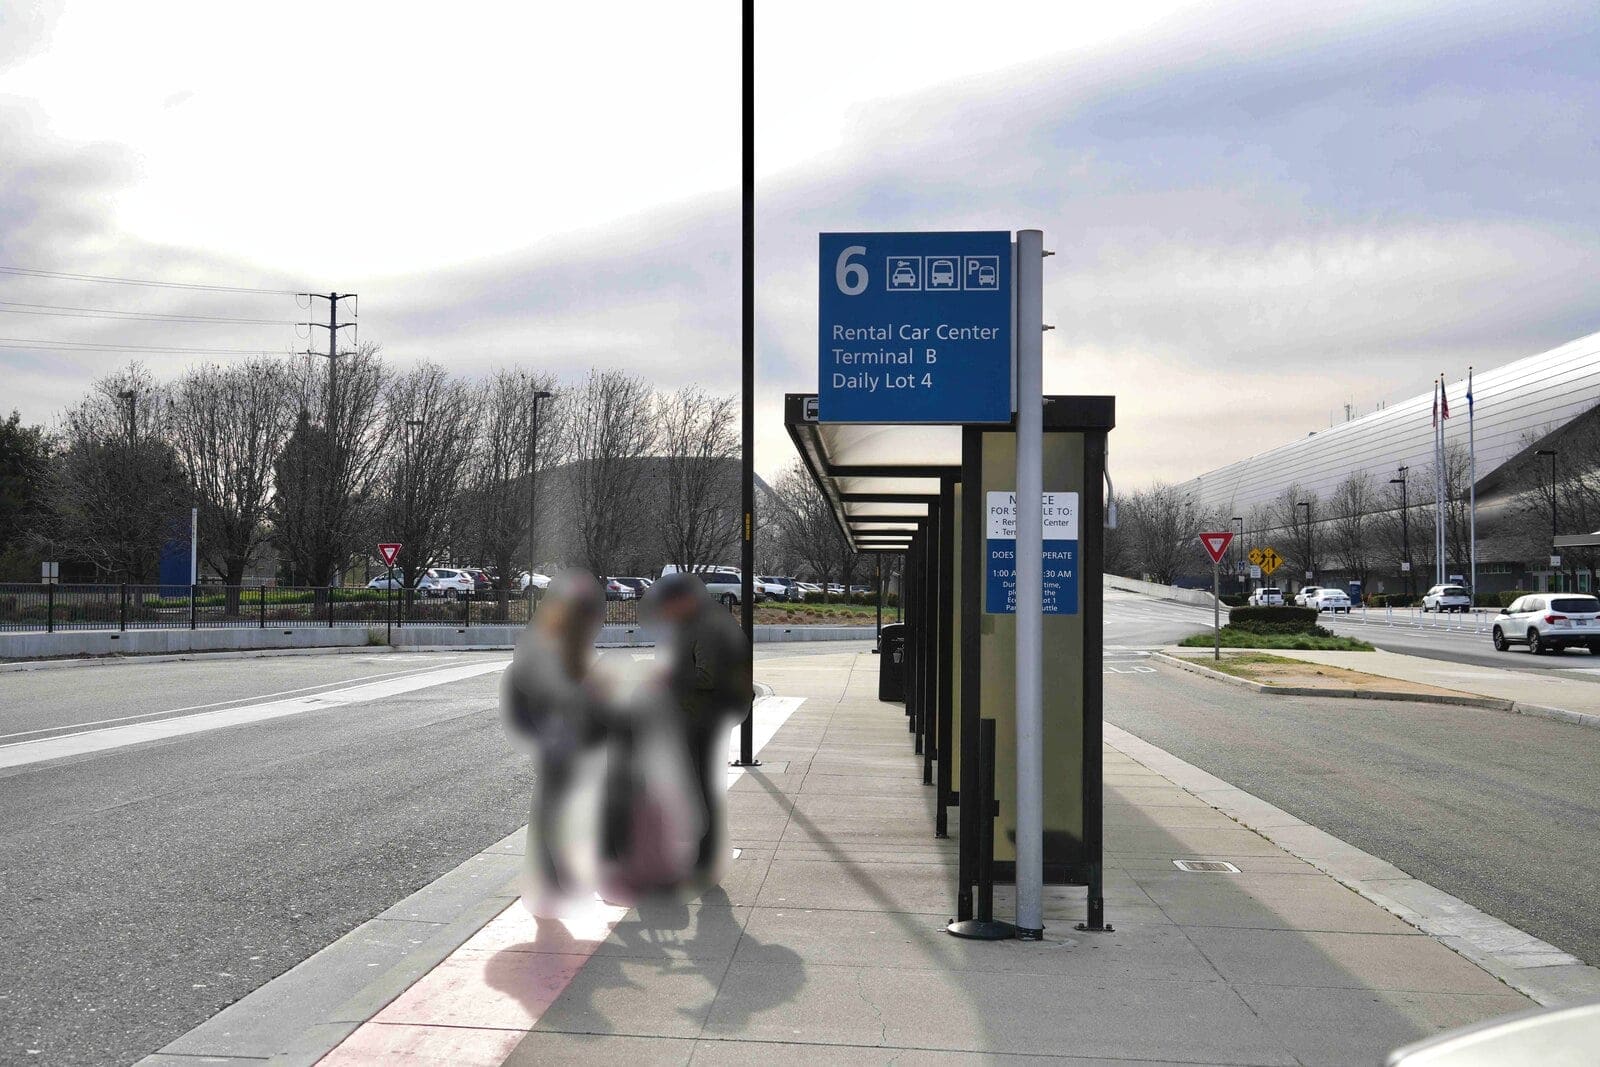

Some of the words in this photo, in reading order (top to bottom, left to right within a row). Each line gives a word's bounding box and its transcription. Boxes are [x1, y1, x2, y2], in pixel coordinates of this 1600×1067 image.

[835, 245, 869, 296] 6
[968, 260, 980, 275] P
[832, 323, 892, 341] Rental
[898, 324, 930, 341] Car
[936, 324, 999, 341] Center
[832, 347, 913, 365] Terminal
[926, 348, 937, 365] B
[832, 372, 880, 392] Daily
[885, 372, 916, 388] Lot
[920, 372, 933, 388] 4
[991, 506, 1009, 515] FOR
[1056, 507, 1073, 516] TO:
[1043, 518, 1069, 527] Center
[992, 551, 1014, 559] DOES
[1042, 551, 1073, 560] PERATE
[993, 569, 1009, 577] 1:00
[1043, 570, 1056, 578] :30
[1057, 570, 1072, 578] AM
